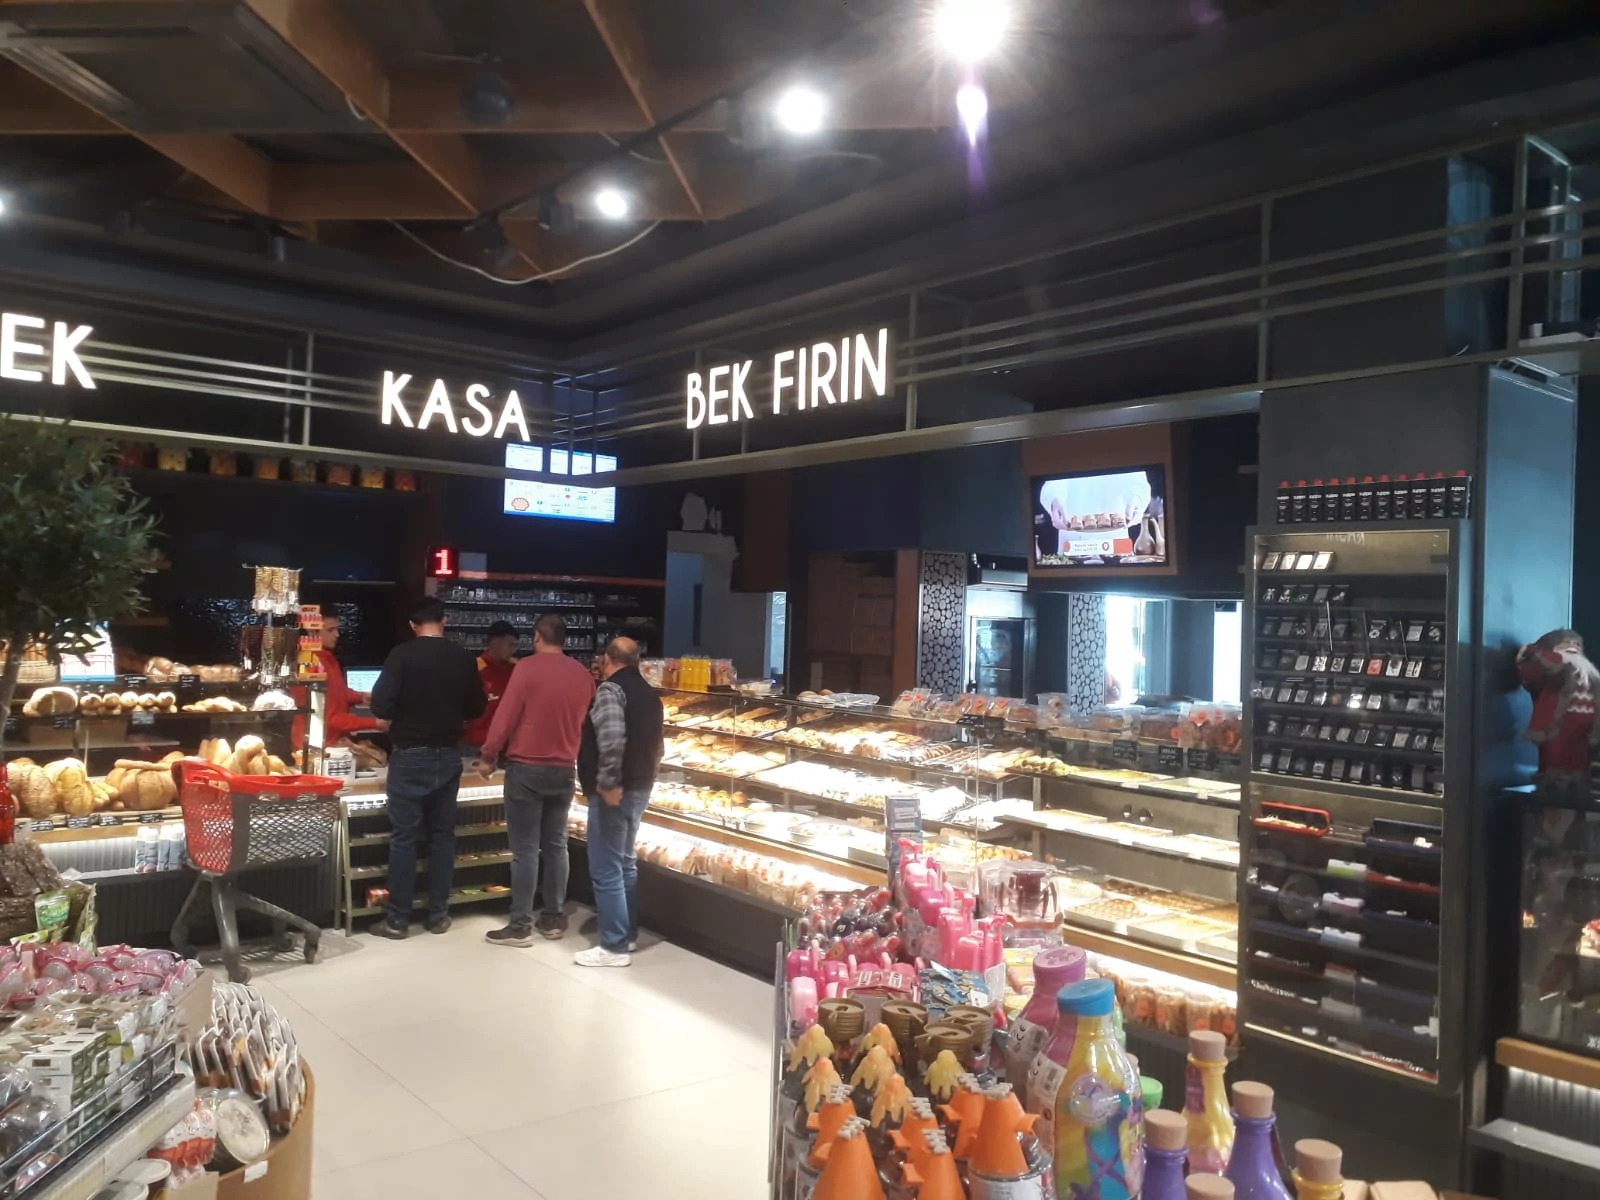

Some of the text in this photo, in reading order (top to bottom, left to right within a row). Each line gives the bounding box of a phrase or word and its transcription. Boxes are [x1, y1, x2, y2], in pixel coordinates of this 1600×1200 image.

[0, 312, 97, 390] EK
[686, 327, 888, 430] BEK FIRIN
[381, 370, 531, 442] KASA
[435, 549, 453, 575] 1
